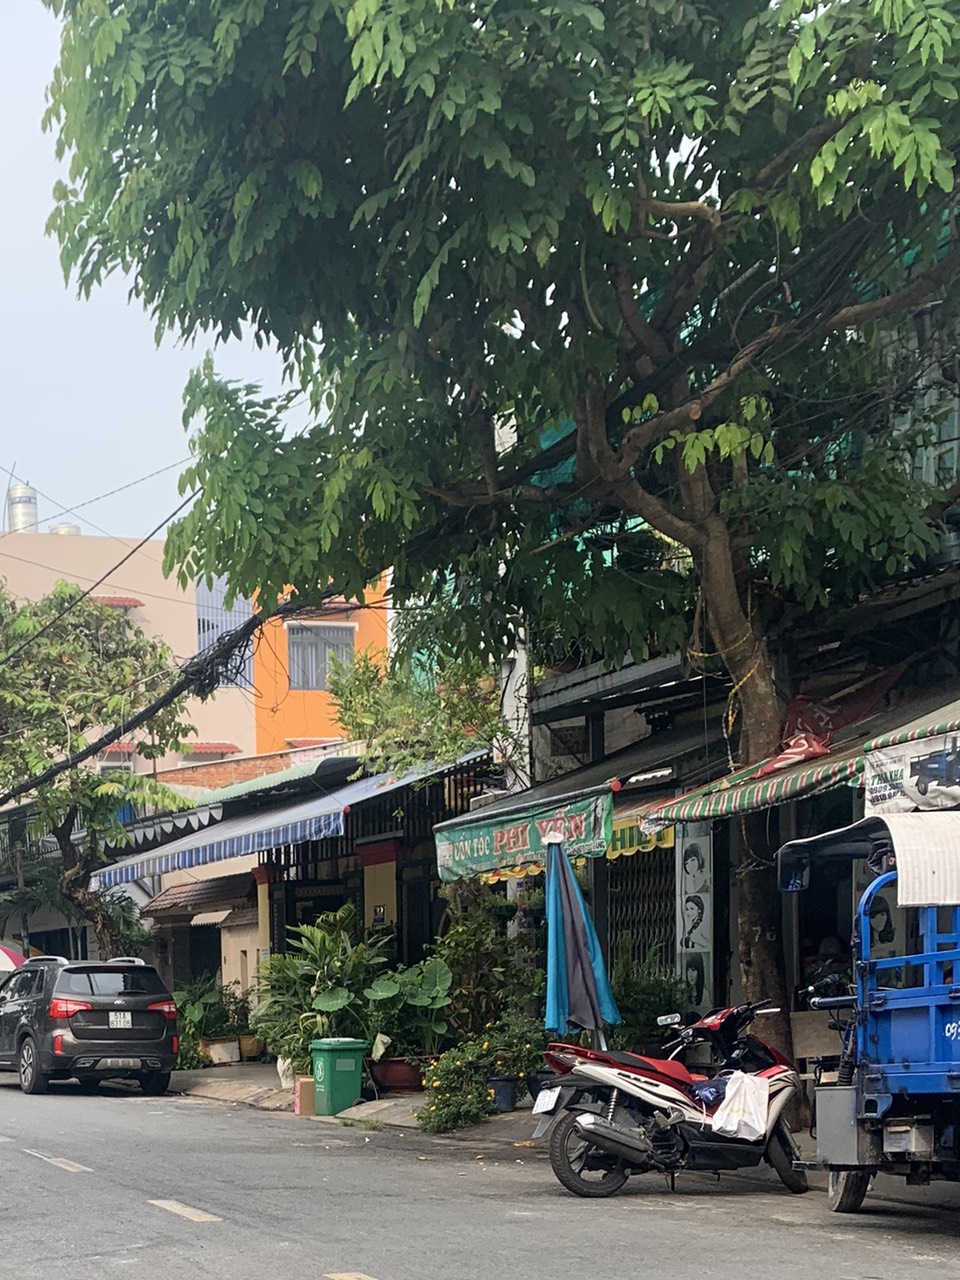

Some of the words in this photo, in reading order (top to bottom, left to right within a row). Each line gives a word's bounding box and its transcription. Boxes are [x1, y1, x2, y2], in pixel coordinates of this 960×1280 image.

[473, 831, 490, 857] TÓC
[493, 822, 530, 856] PHI
[114, 1012, 127, 1020] 51A
[945, 1022, 960, 1040] 09
